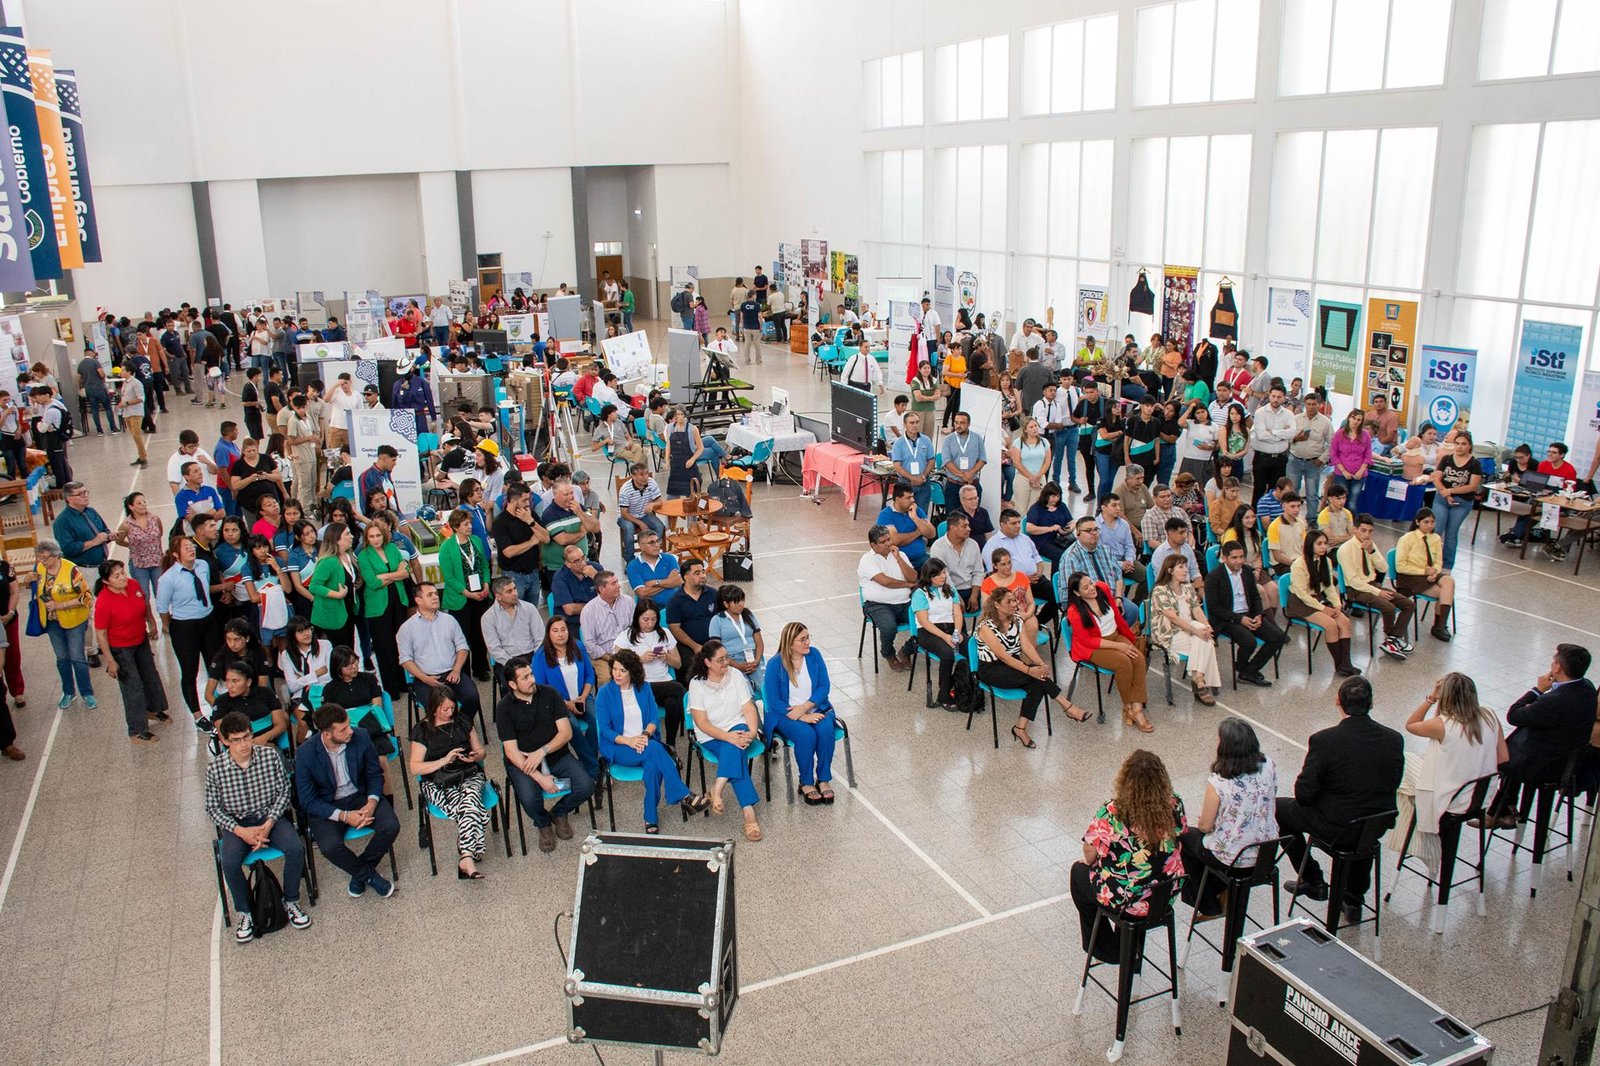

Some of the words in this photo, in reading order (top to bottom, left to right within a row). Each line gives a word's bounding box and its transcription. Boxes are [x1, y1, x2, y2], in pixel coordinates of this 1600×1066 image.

[1530, 348, 1566, 369] iSti
[1429, 359, 1468, 383] iSti
[1286, 984, 1330, 1027] PANCHO
[1331, 1019, 1361, 1051] ARCE
[1304, 1015, 1320, 1035] VIDEO
